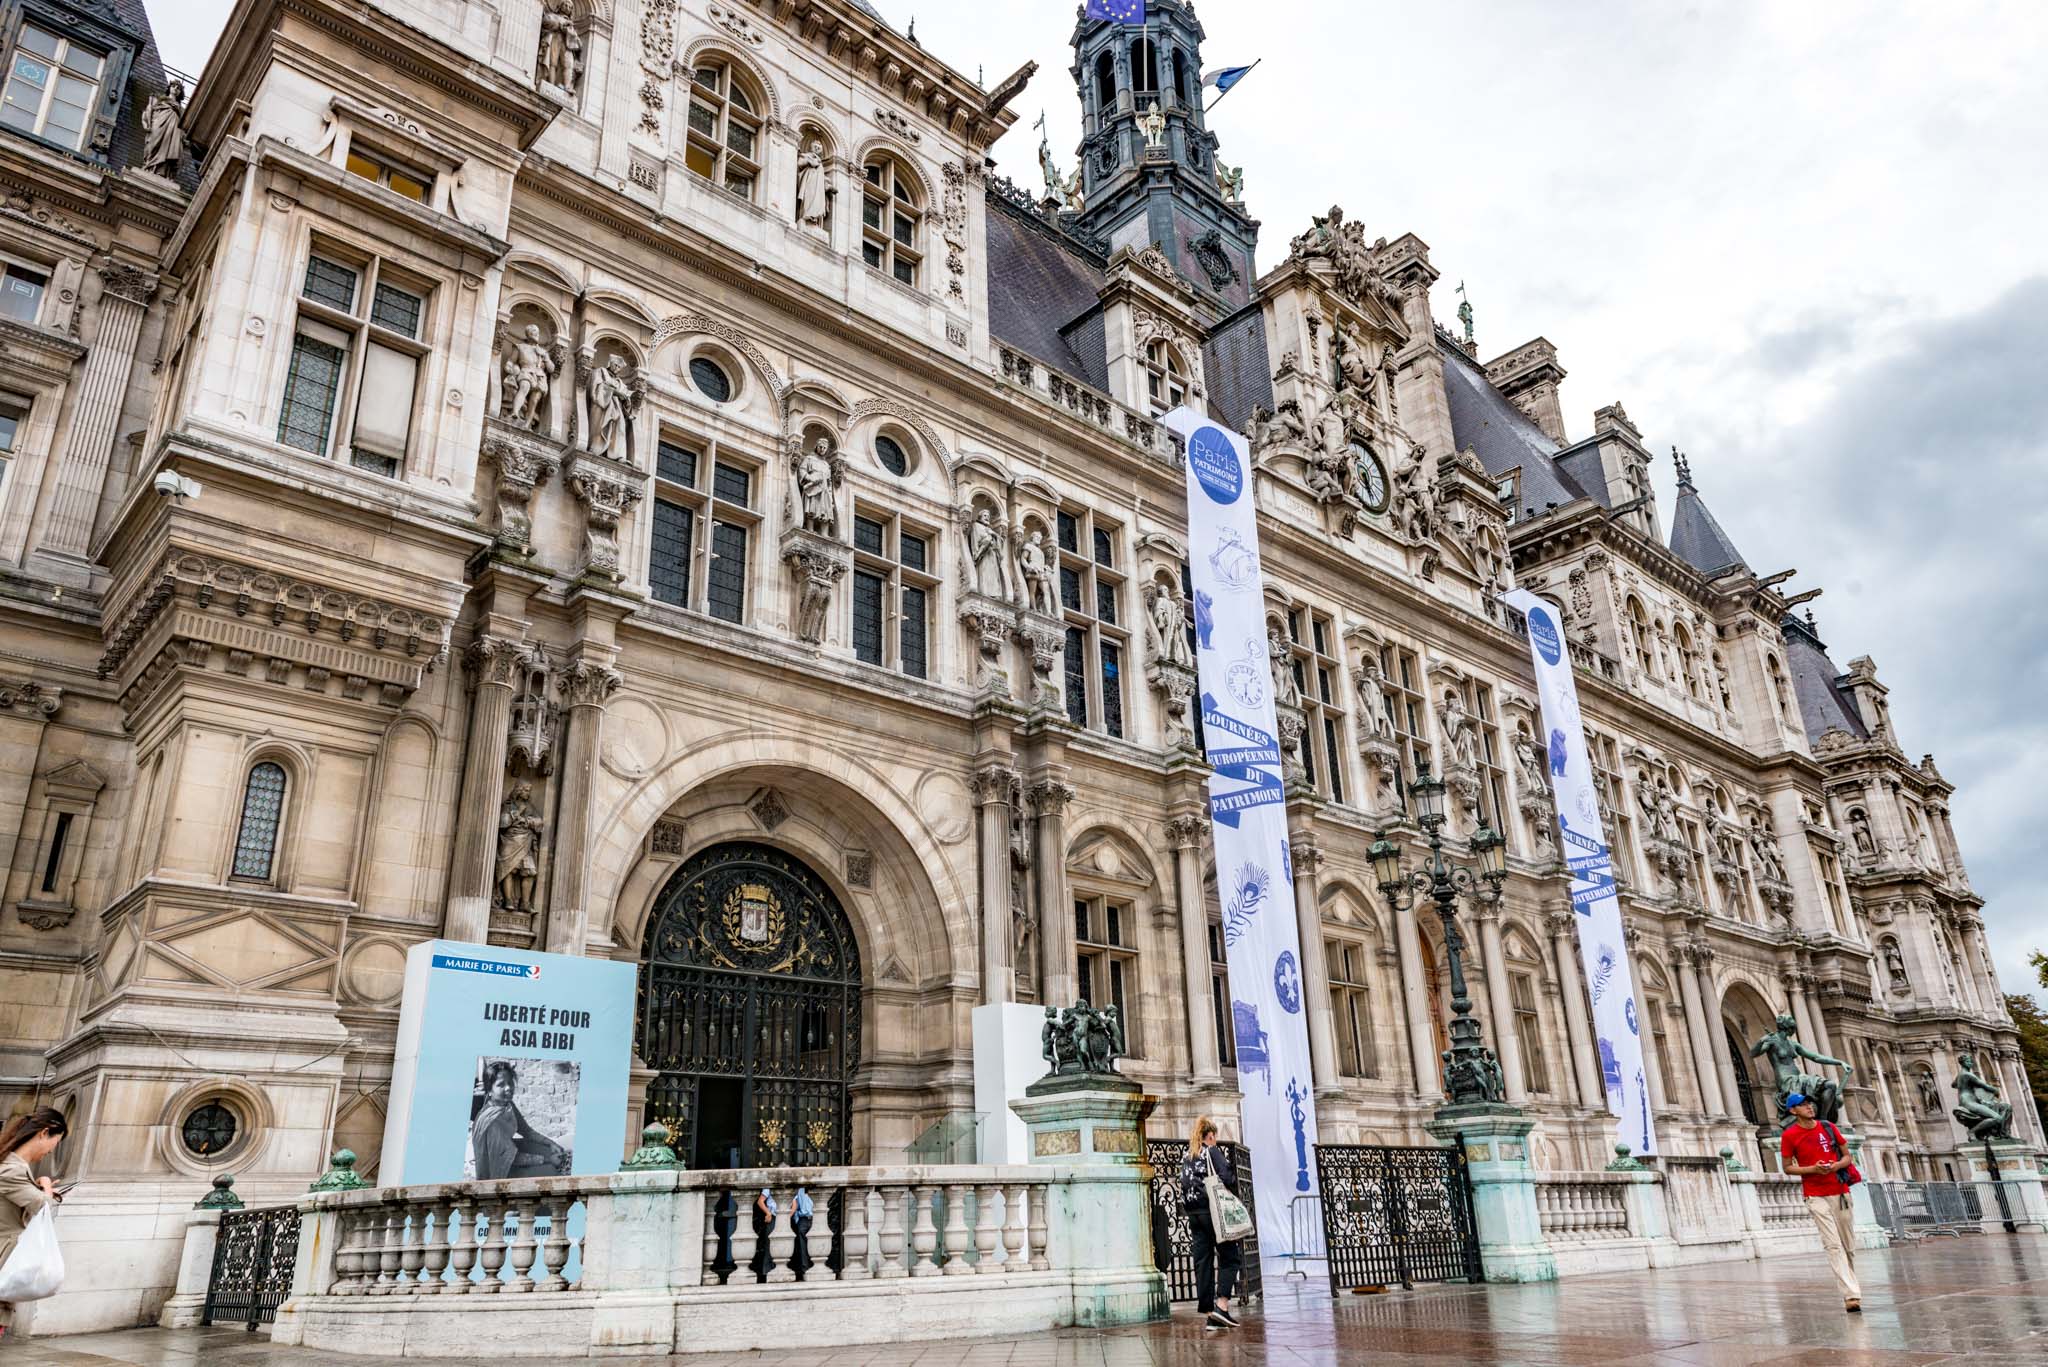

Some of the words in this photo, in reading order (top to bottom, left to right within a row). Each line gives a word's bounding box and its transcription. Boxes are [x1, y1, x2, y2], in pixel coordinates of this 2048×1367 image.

[1193, 438, 1238, 474] Paris
[1205, 711, 1269, 746] JOURNÉES
[1246, 767, 1264, 784] DU
[1588, 871, 1601, 884] DU
[445, 959, 479, 970] MAIRIE
[481, 962, 494, 971] DE
[496, 964, 521, 975] PARIS
[484, 1002, 547, 1025] LIBERTÉ
[550, 1008, 591, 1029] POUR
[500, 1028, 537, 1048] ASIA
[541, 1031, 575, 1051] BIBI
